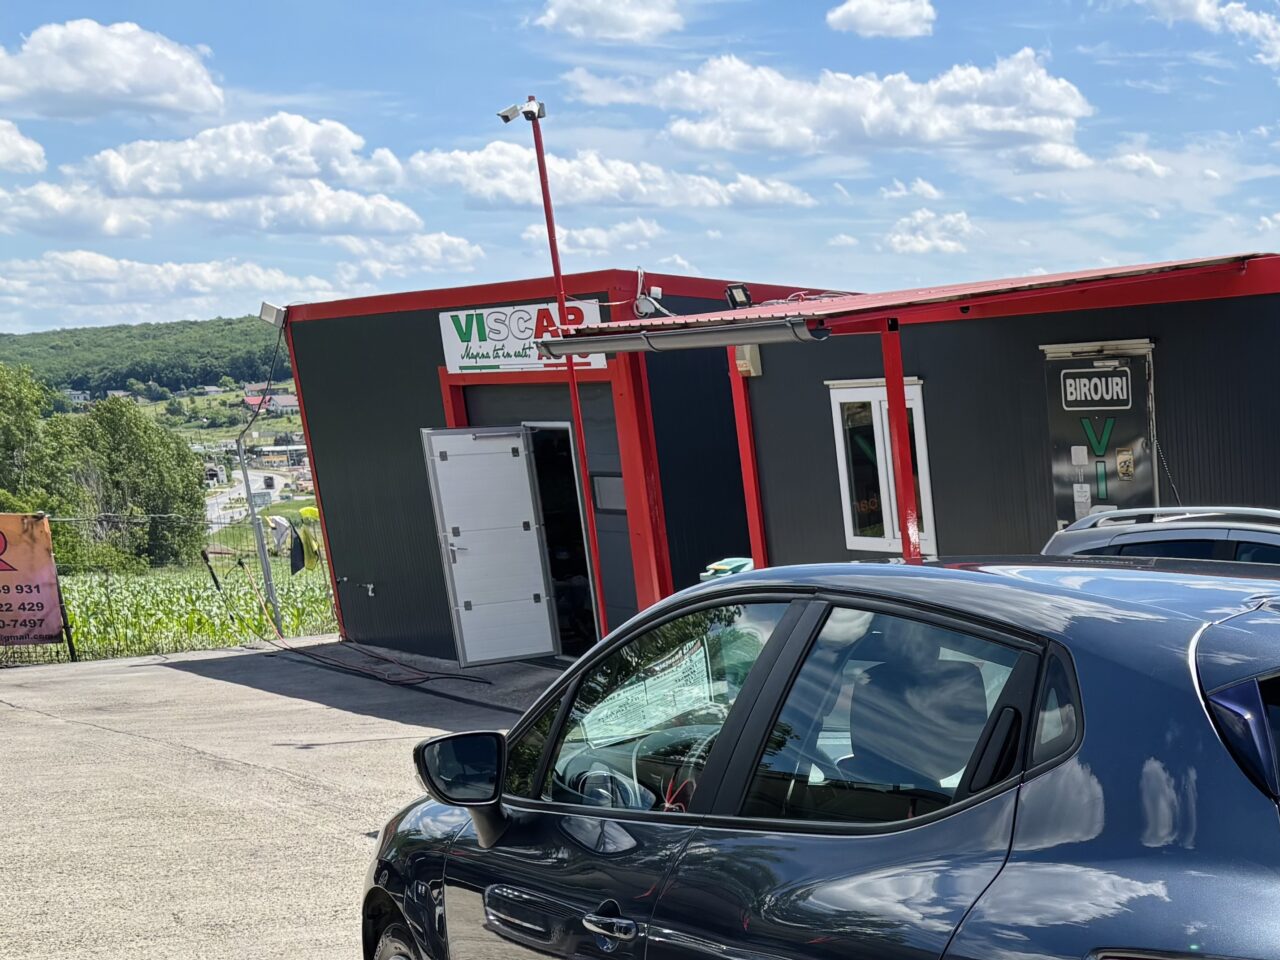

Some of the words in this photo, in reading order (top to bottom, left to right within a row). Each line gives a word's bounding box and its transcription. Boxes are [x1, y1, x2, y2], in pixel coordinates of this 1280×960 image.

[1065, 376, 1128, 401] BIROURI
[15, 584, 41, 594] 931
[17, 602, 44, 612] 429
